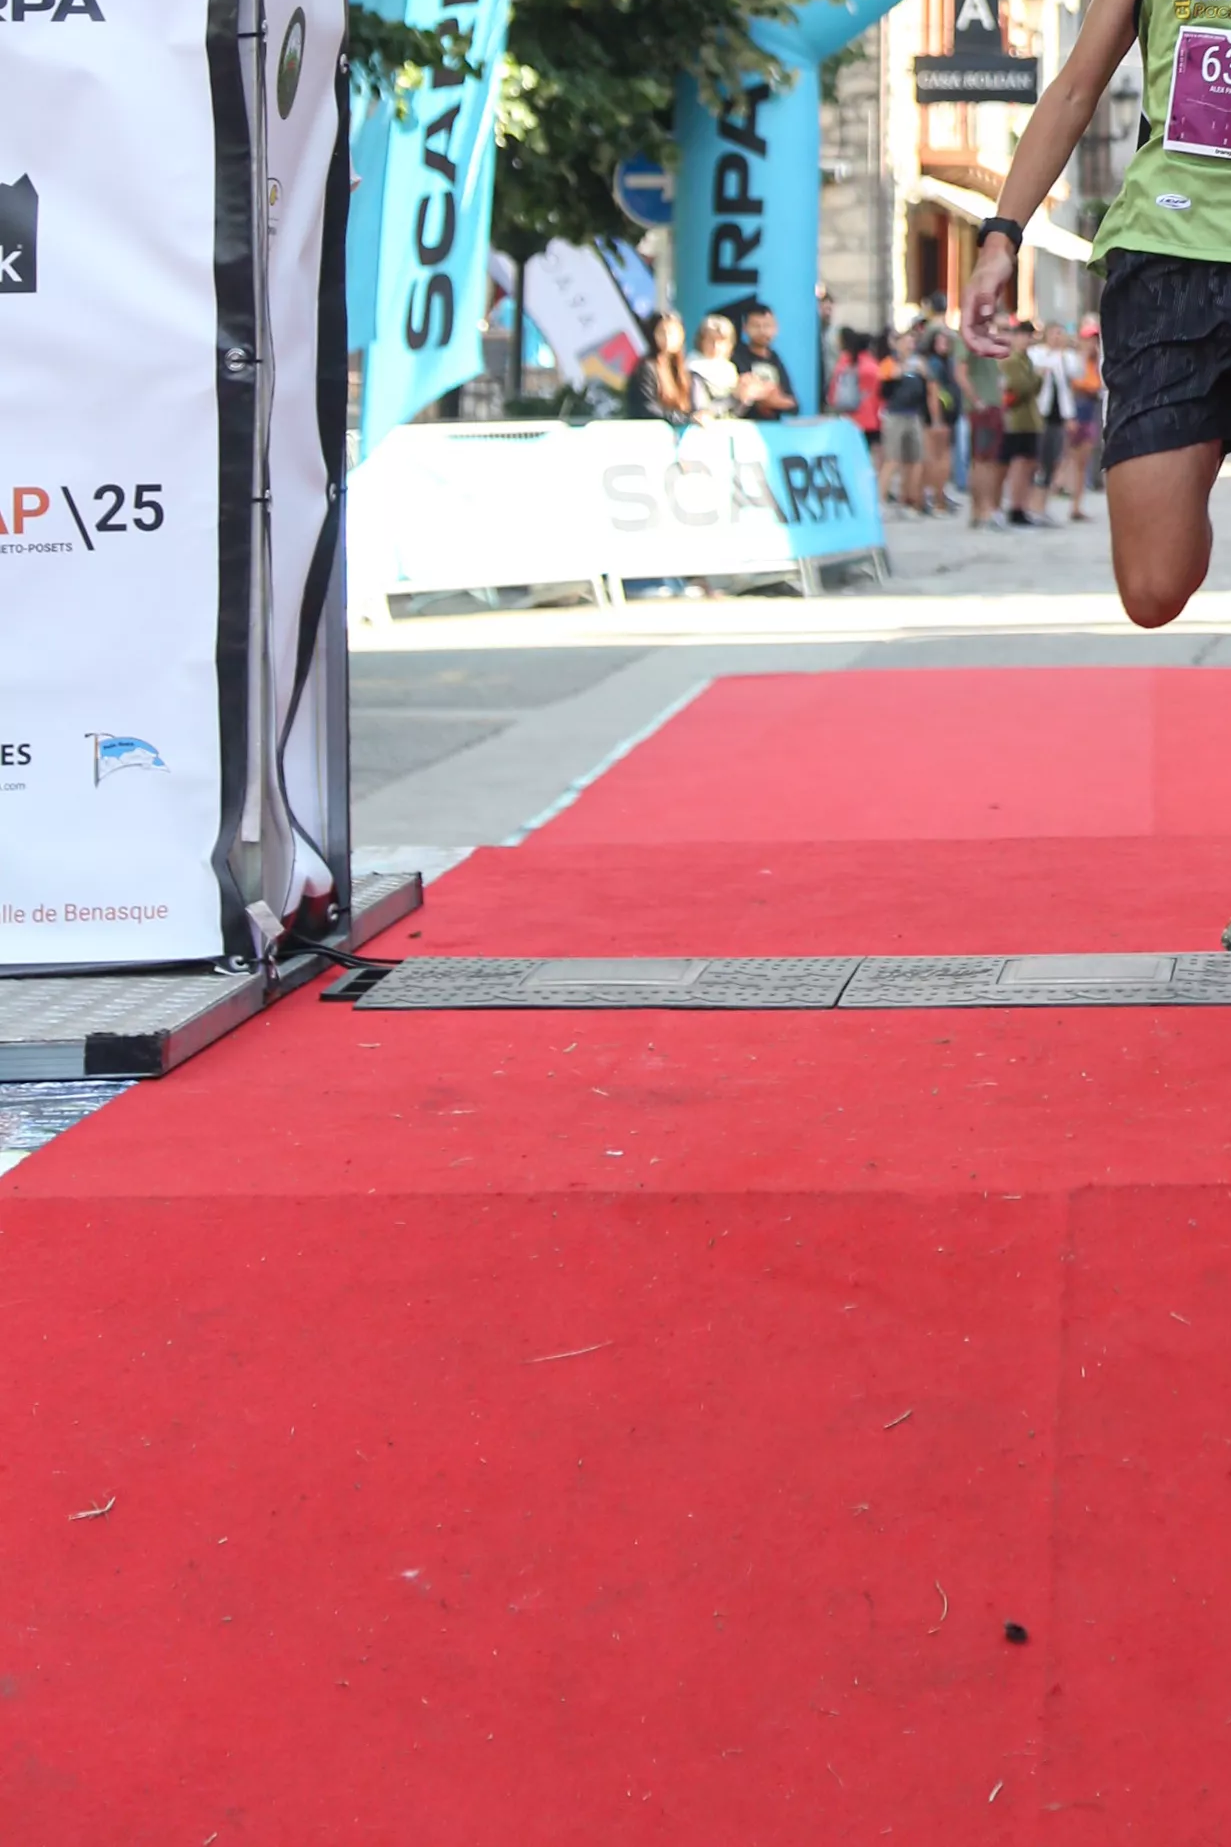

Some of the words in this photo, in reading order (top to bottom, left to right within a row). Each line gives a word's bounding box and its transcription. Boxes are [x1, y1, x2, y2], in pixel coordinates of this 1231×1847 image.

[1209, 85, 1224, 94] ALEX
[32, 903, 57, 923] de
[63, 902, 168, 923] Benasque
